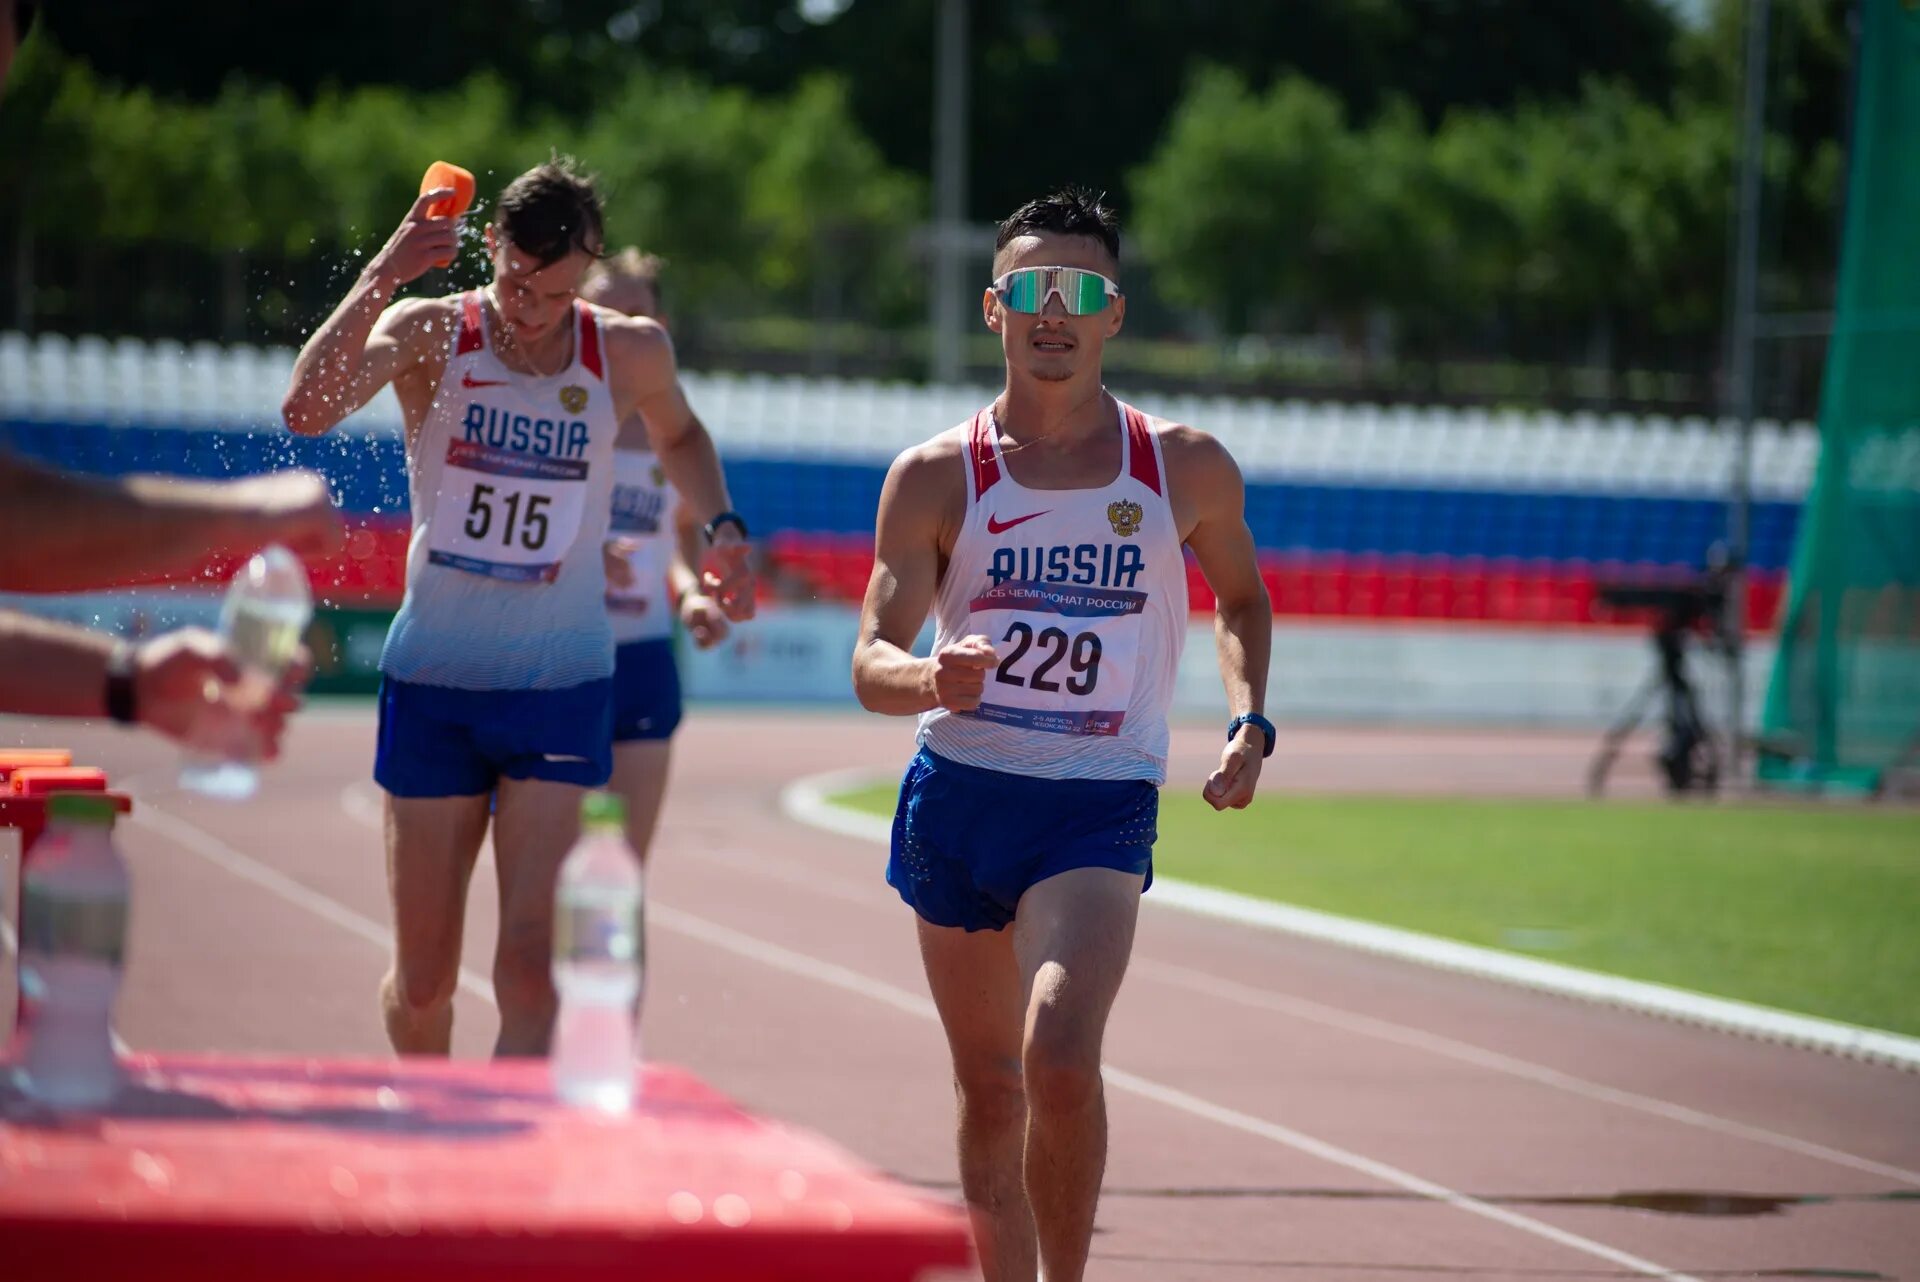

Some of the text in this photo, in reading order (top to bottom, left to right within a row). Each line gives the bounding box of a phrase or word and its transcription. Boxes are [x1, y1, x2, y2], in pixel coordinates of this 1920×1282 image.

[462, 403, 590, 458] RUSSIA
[464, 483, 552, 551] 515
[987, 543, 1146, 588] RUSSIA
[1008, 589, 1084, 606] ЧЕМПИОНАТ
[1086, 598, 1137, 610] РОССИИ
[995, 621, 1103, 696] 229
